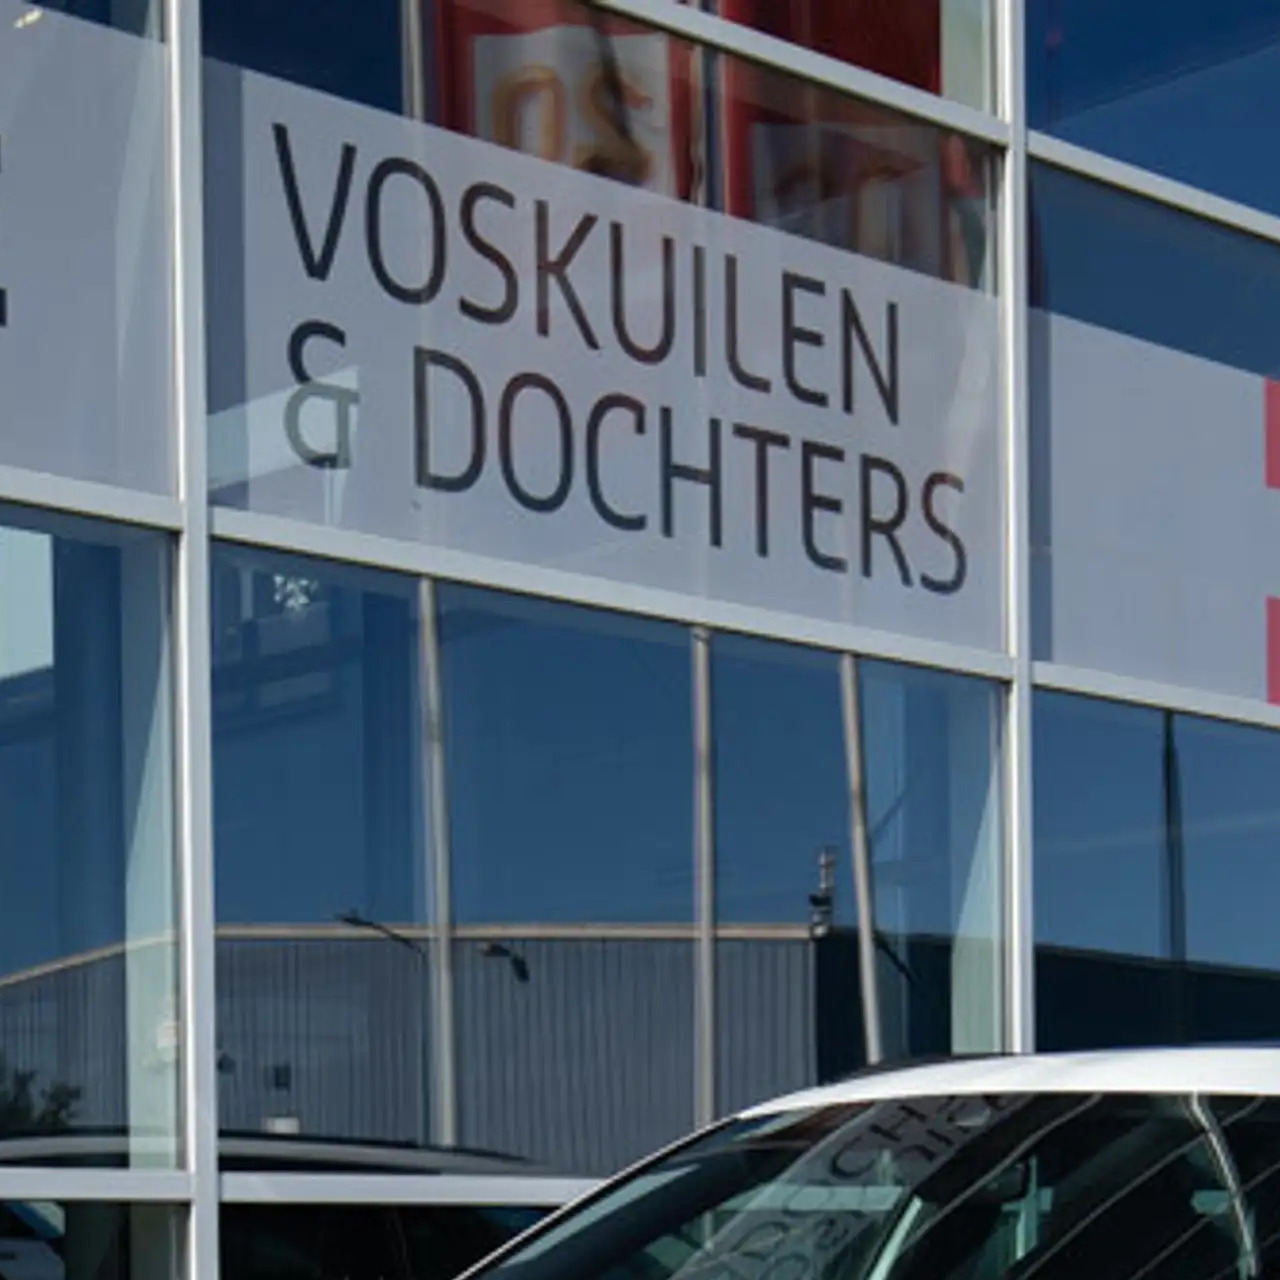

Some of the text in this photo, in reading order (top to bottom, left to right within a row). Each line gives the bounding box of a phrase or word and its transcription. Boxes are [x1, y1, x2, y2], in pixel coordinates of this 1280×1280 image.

[272, 122, 899, 426] VOSKUILEN
[283, 320, 968, 595] & DOCHTERS
